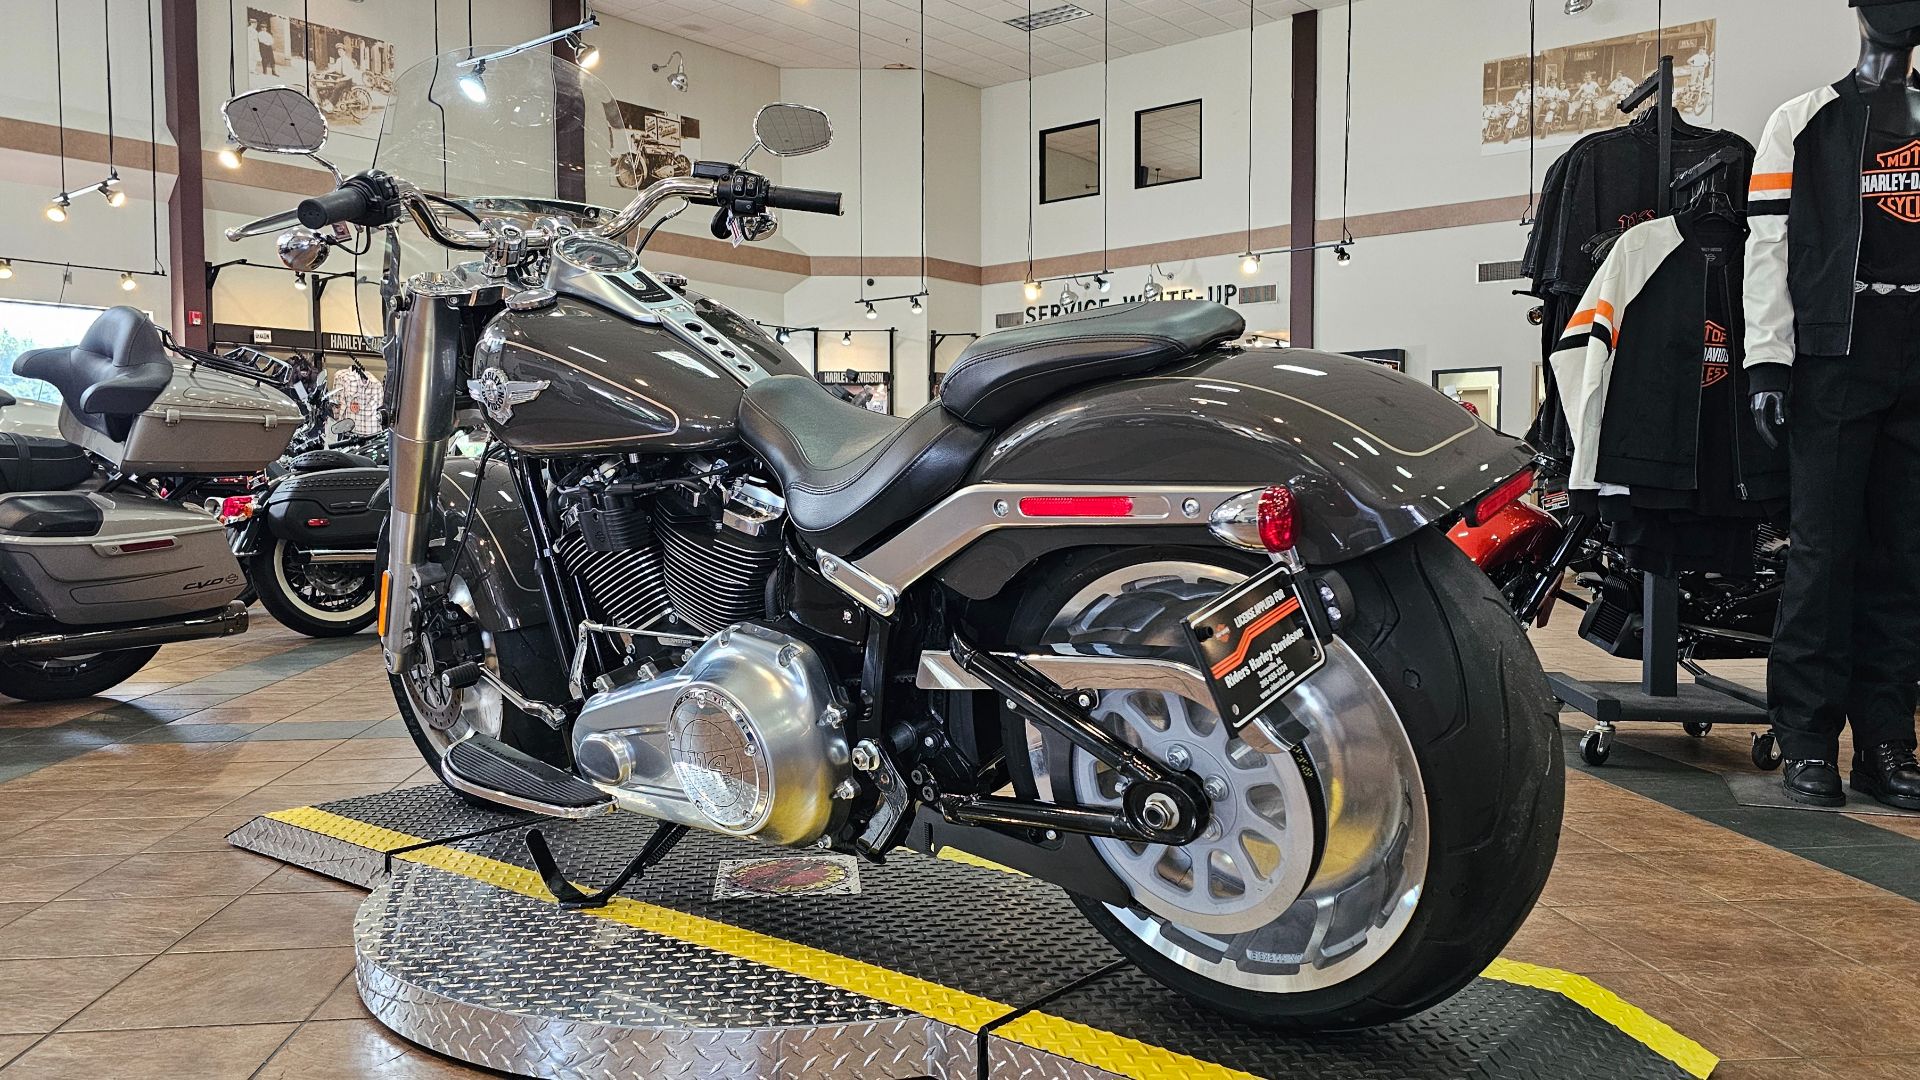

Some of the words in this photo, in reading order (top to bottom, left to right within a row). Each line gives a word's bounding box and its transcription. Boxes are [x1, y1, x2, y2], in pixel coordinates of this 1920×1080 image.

[1861, 172, 1920, 194] HARLEY-D
[183, 577, 224, 590] CVO
[1233, 606, 1257, 628] LICENSE
[1253, 595, 1276, 616] APPLIED
[1272, 588, 1286, 603] FOR
[1224, 665, 1251, 689] Riders
